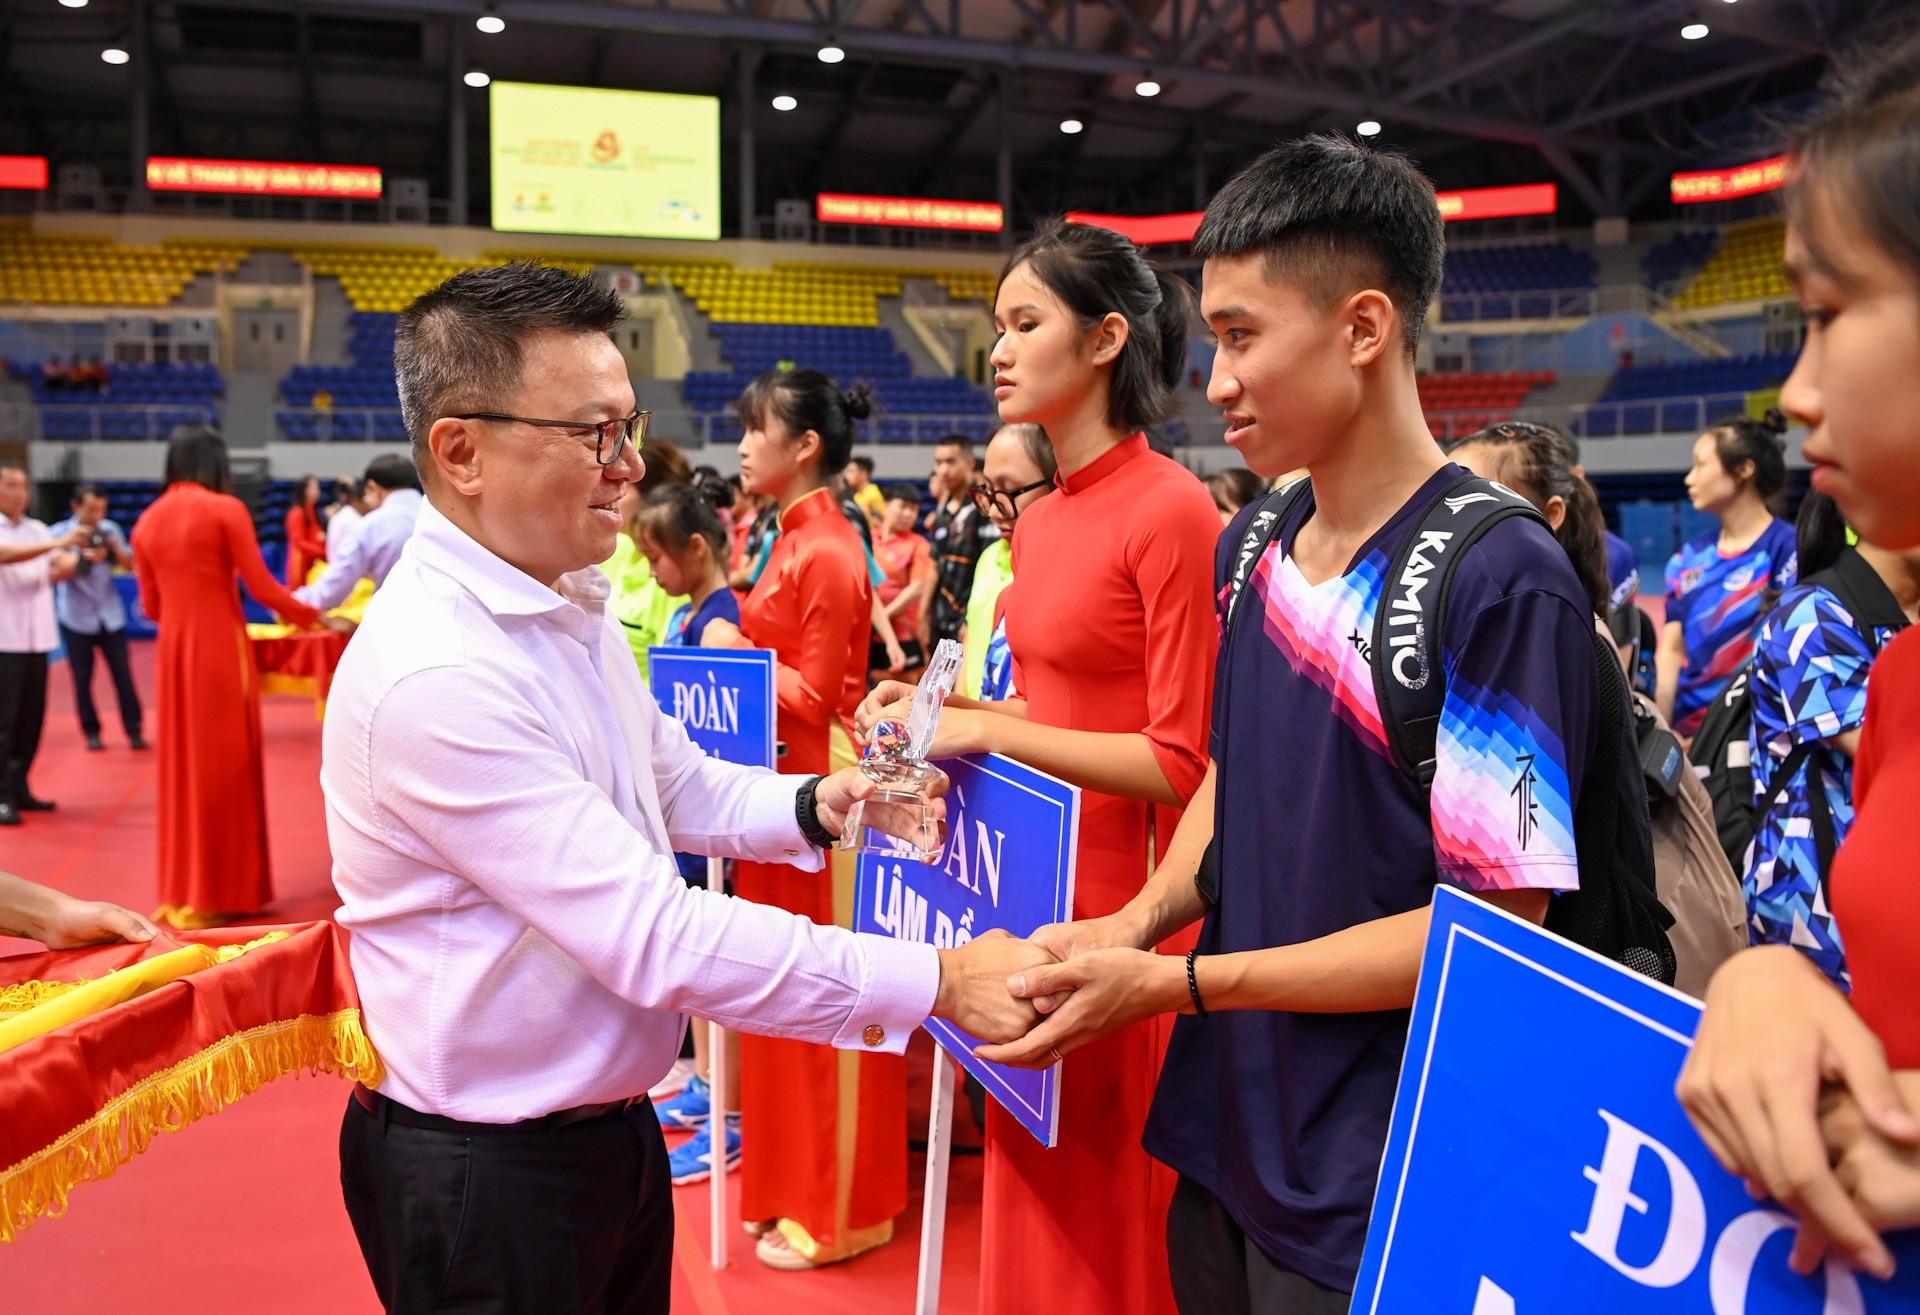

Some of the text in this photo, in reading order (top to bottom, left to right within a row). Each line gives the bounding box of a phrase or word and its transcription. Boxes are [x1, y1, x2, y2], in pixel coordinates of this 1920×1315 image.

[1389, 531, 1453, 690] KAMITO
[673, 670, 739, 735] ĐOÀN
[874, 864, 928, 949] LÂM
